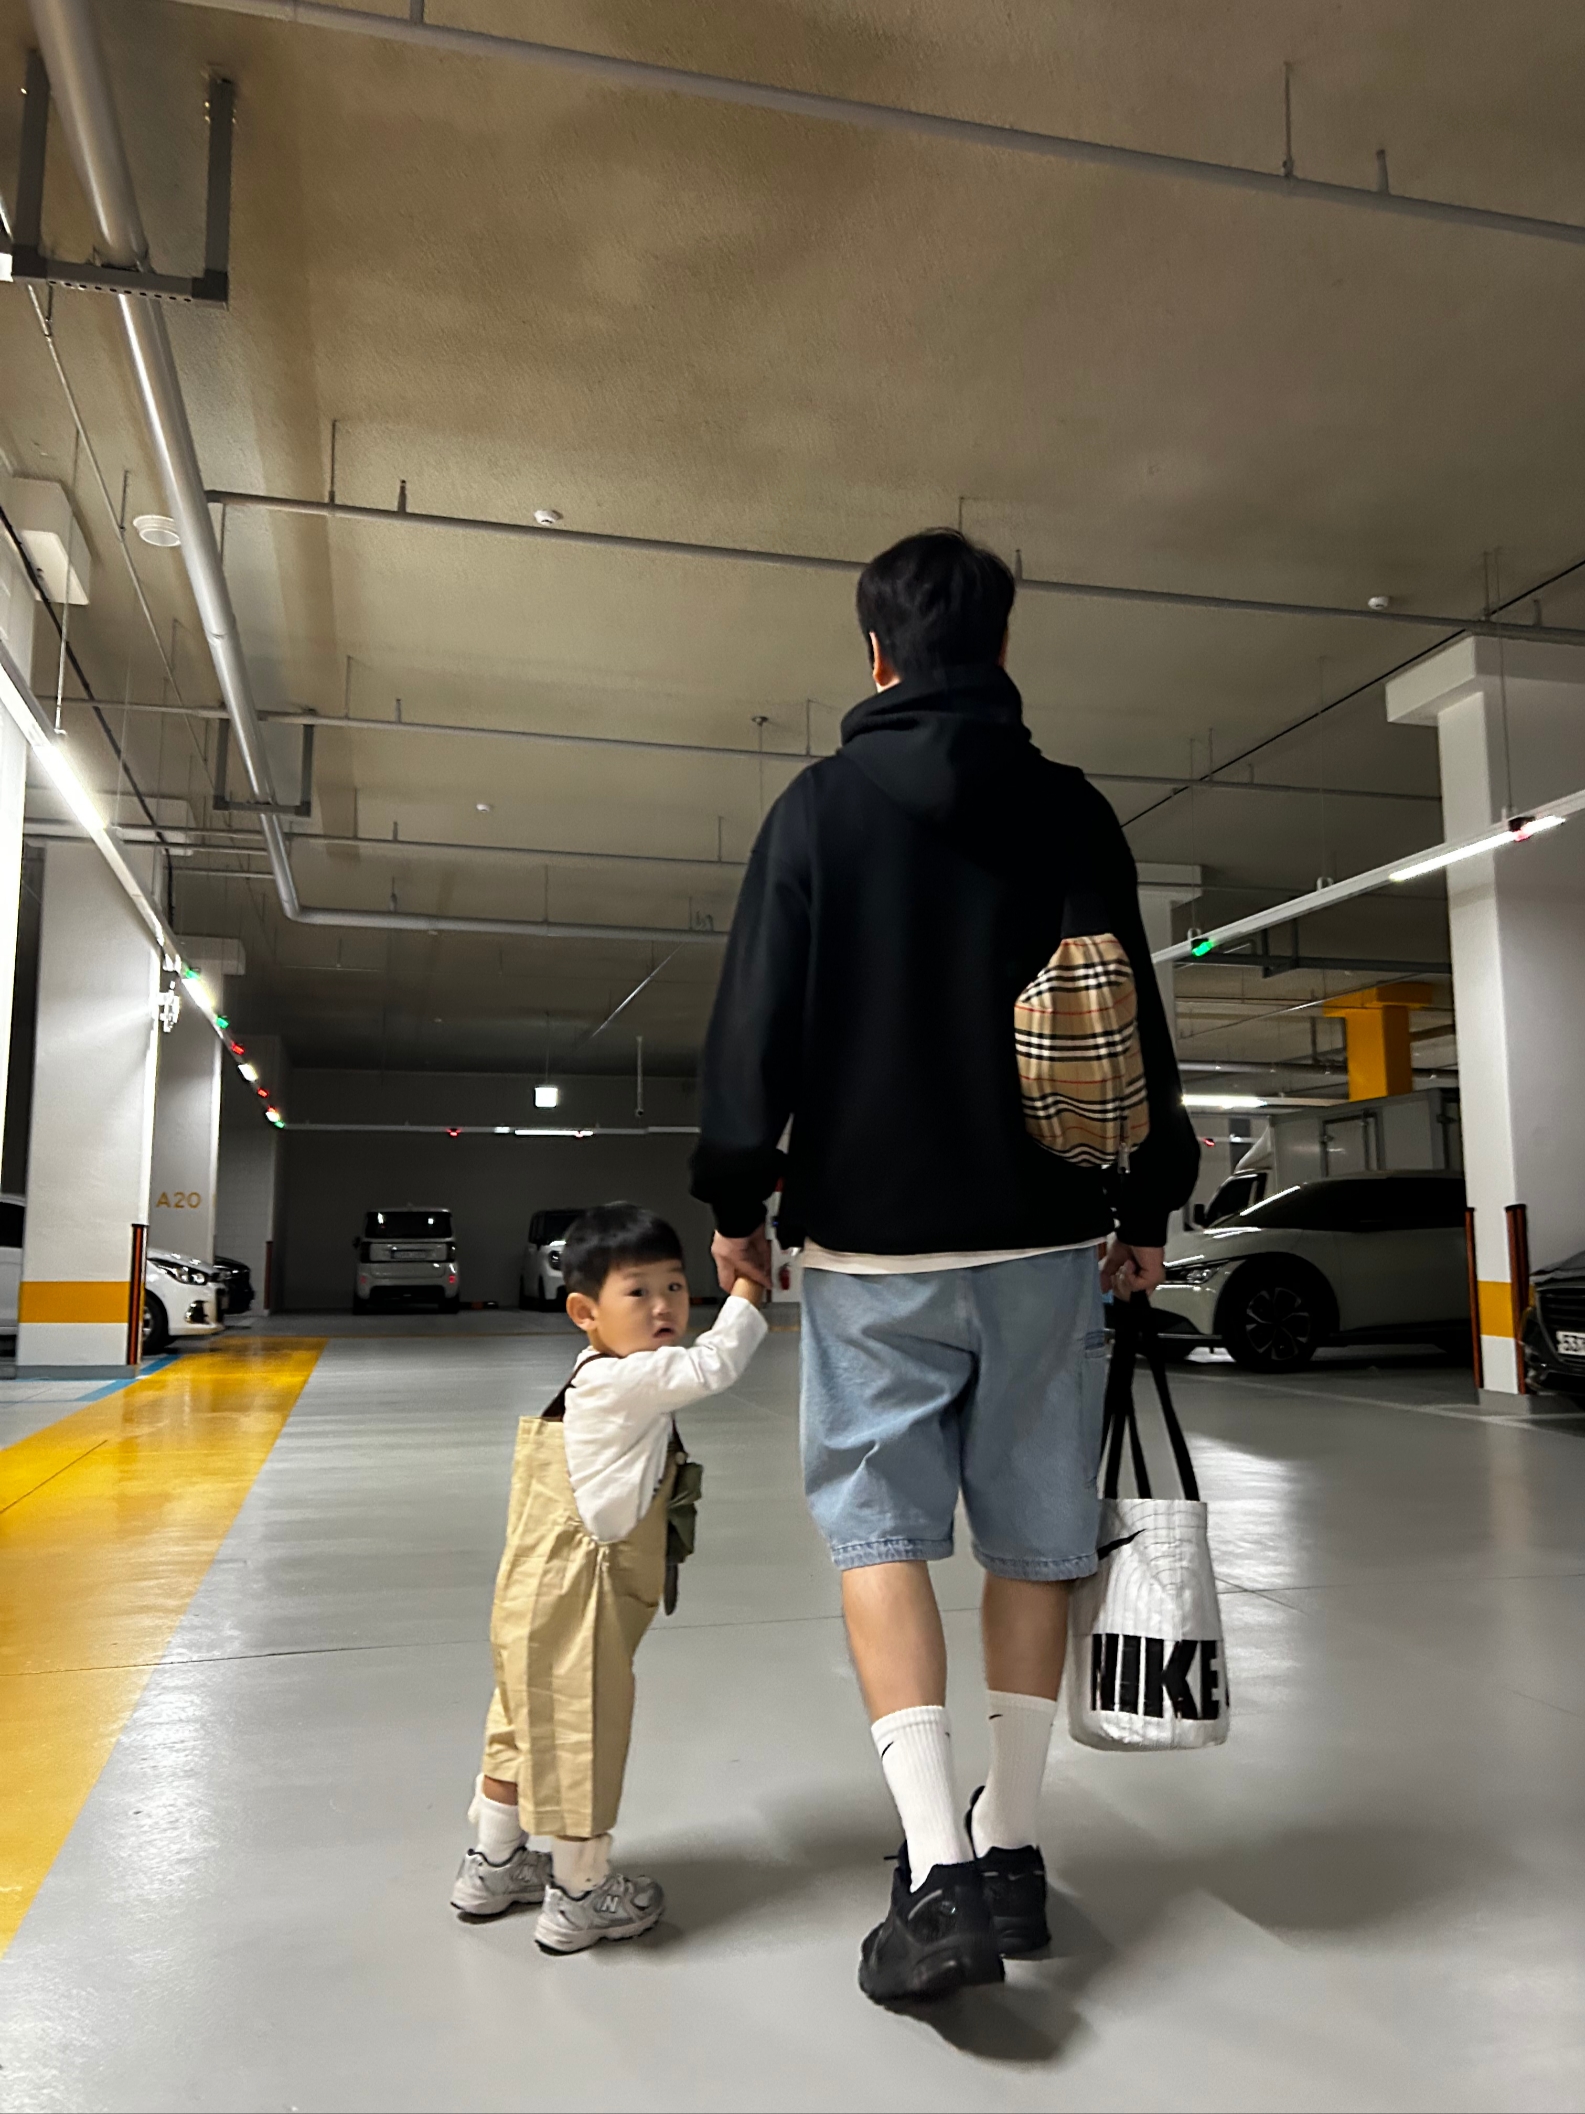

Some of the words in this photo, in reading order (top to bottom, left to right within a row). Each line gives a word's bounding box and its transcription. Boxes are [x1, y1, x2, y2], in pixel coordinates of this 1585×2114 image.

[156, 1191, 202, 1208] A20
[1091, 1633, 1220, 1719] NIKE
[600, 1895, 619, 1913] N
